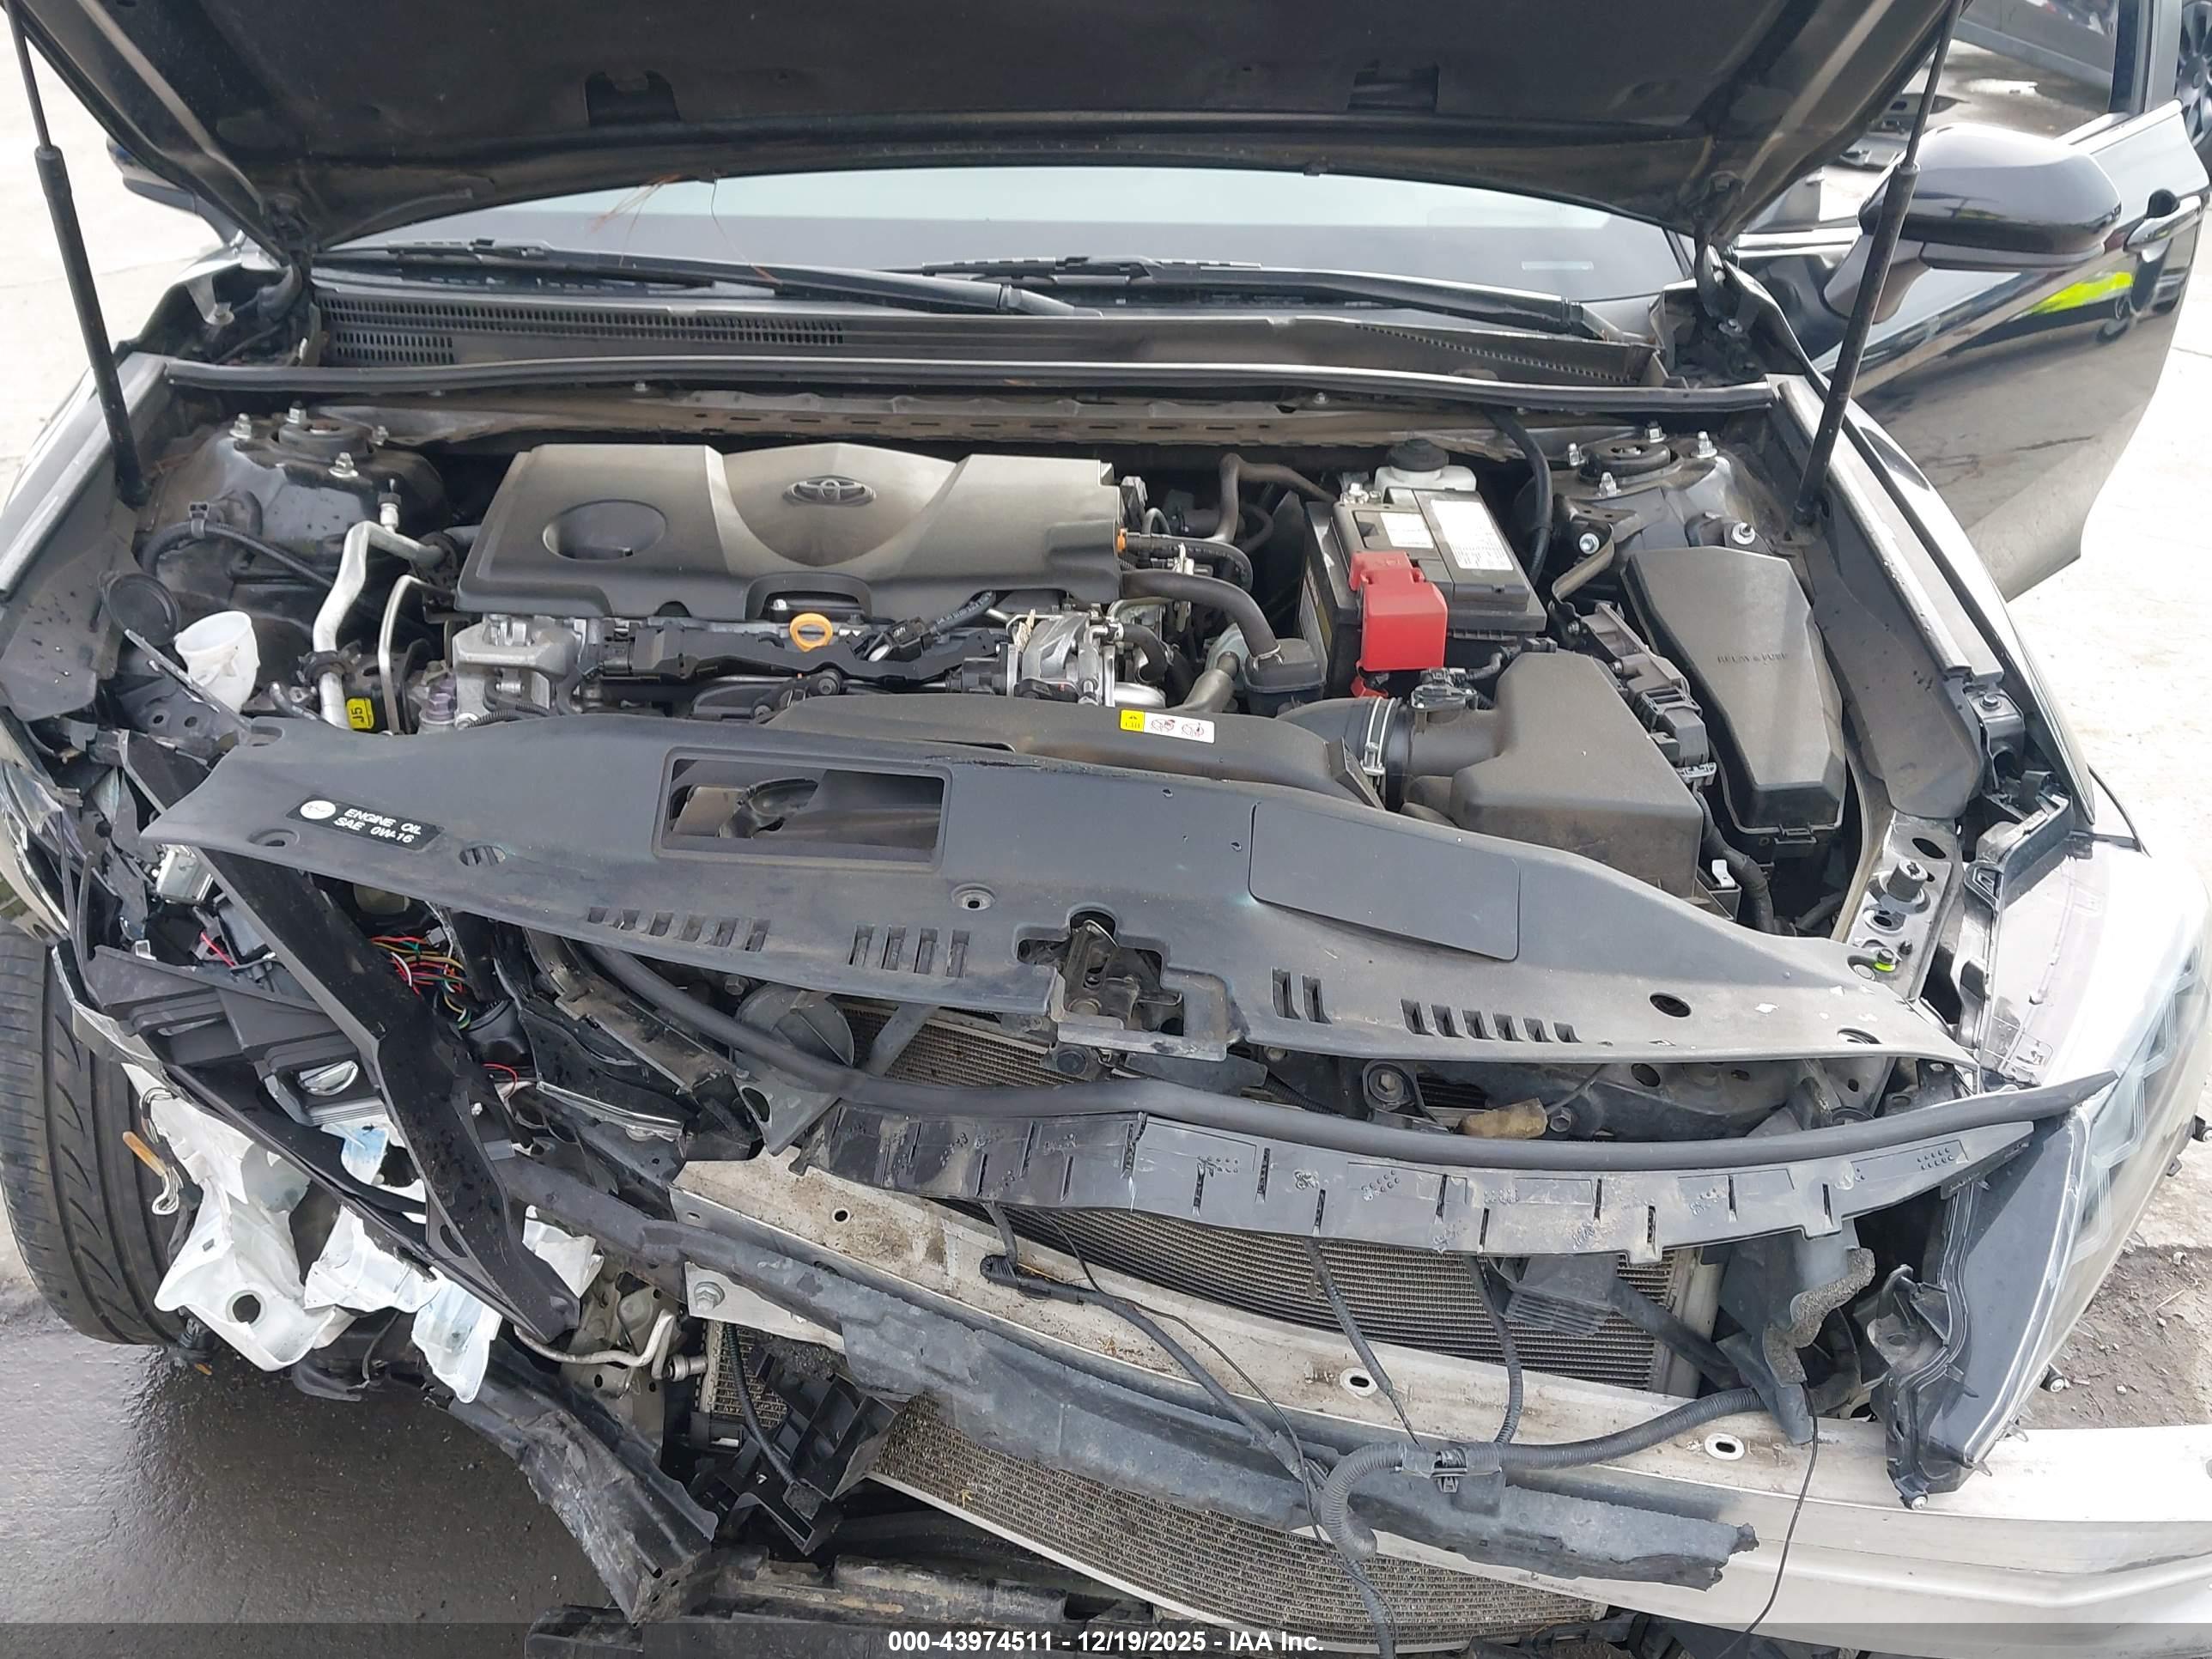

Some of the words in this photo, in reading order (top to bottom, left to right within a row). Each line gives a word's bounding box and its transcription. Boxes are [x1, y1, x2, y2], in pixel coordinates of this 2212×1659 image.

[350, 707, 365, 723] J5
[333, 817, 366, 831] SAE
[370, 826, 415, 843] 0W-16
[343, 808, 397, 828] ENGINE
[400, 823, 422, 836] OIL
